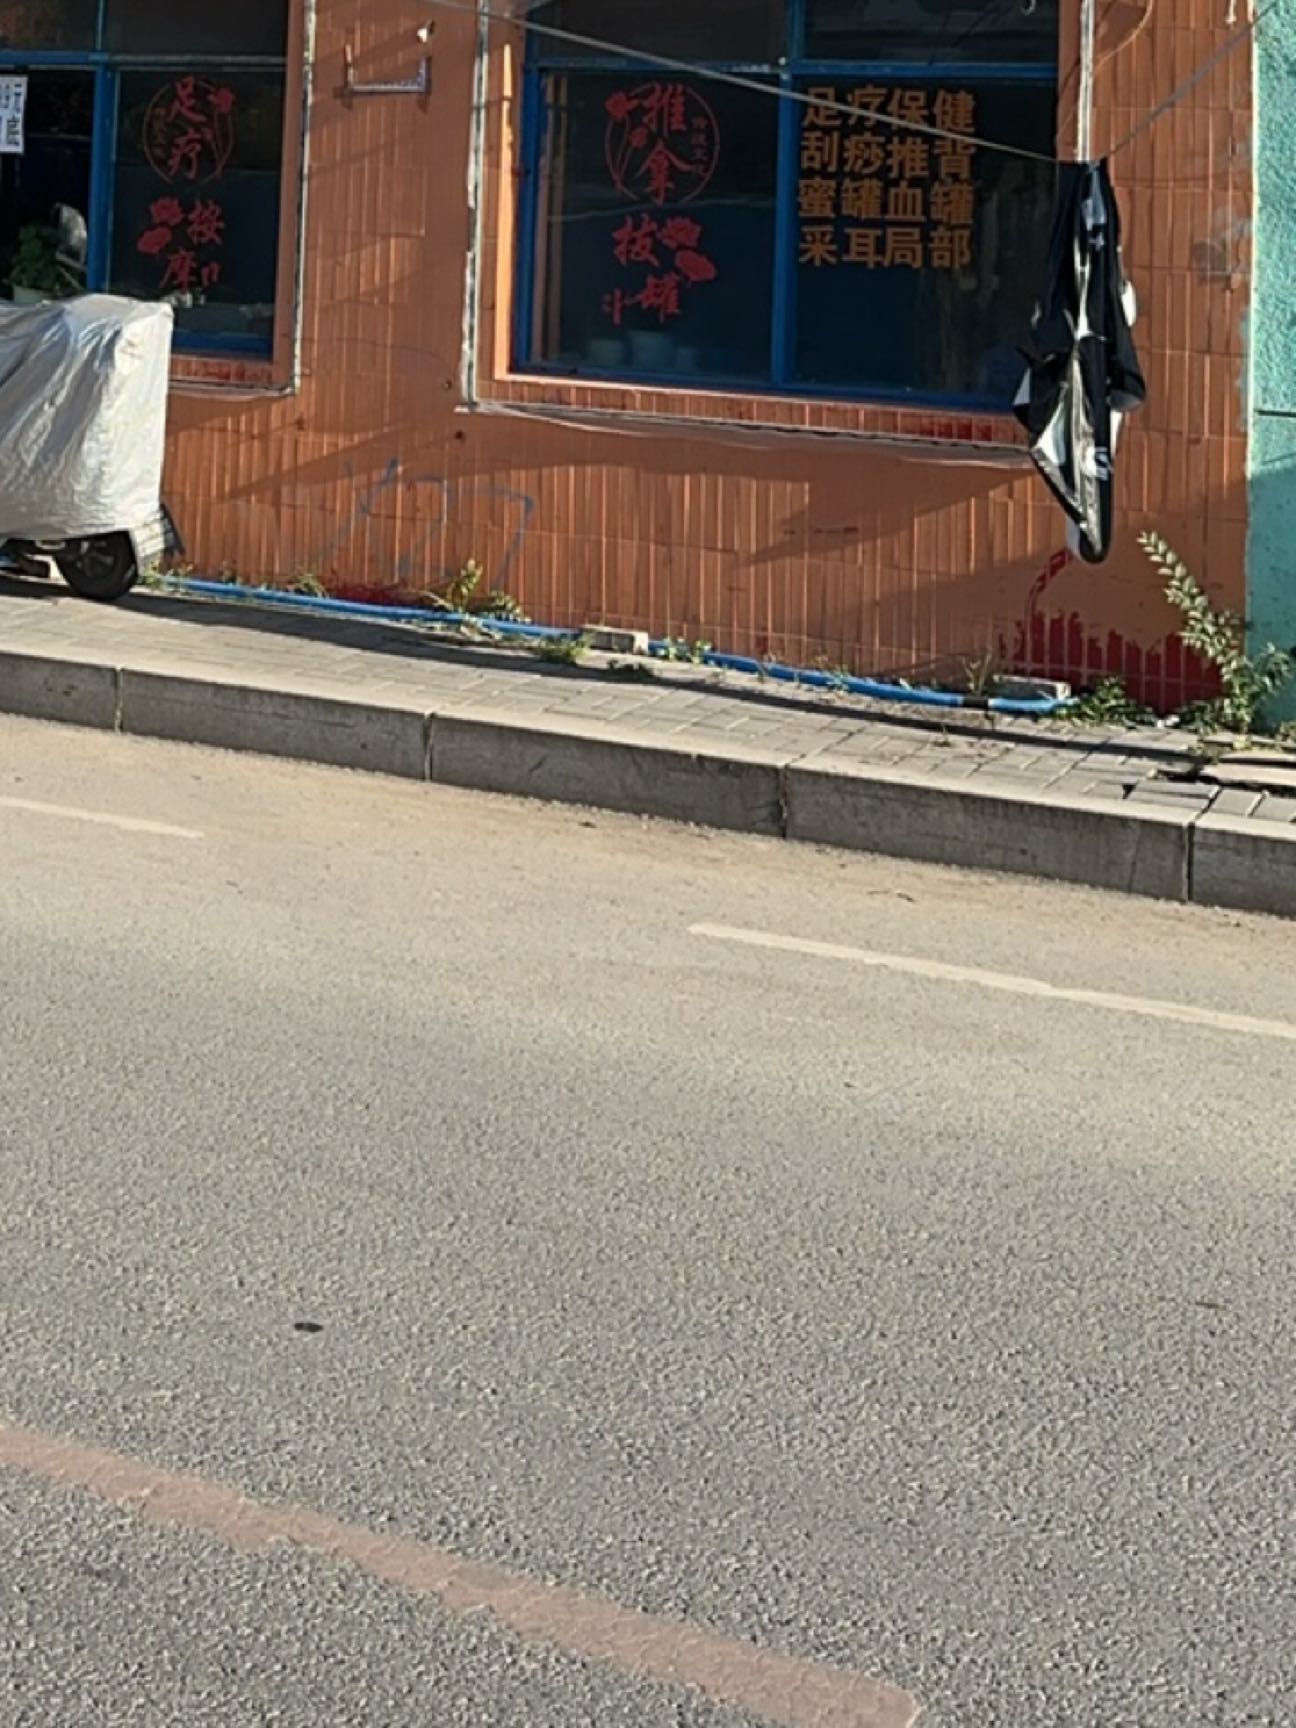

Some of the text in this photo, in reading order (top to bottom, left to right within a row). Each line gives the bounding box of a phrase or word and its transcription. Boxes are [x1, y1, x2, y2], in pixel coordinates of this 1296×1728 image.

[802, 85, 975, 133] 足疗保健
[800, 129, 977, 181] 刮痧推背
[798, 223, 973, 270] 采耳局部
